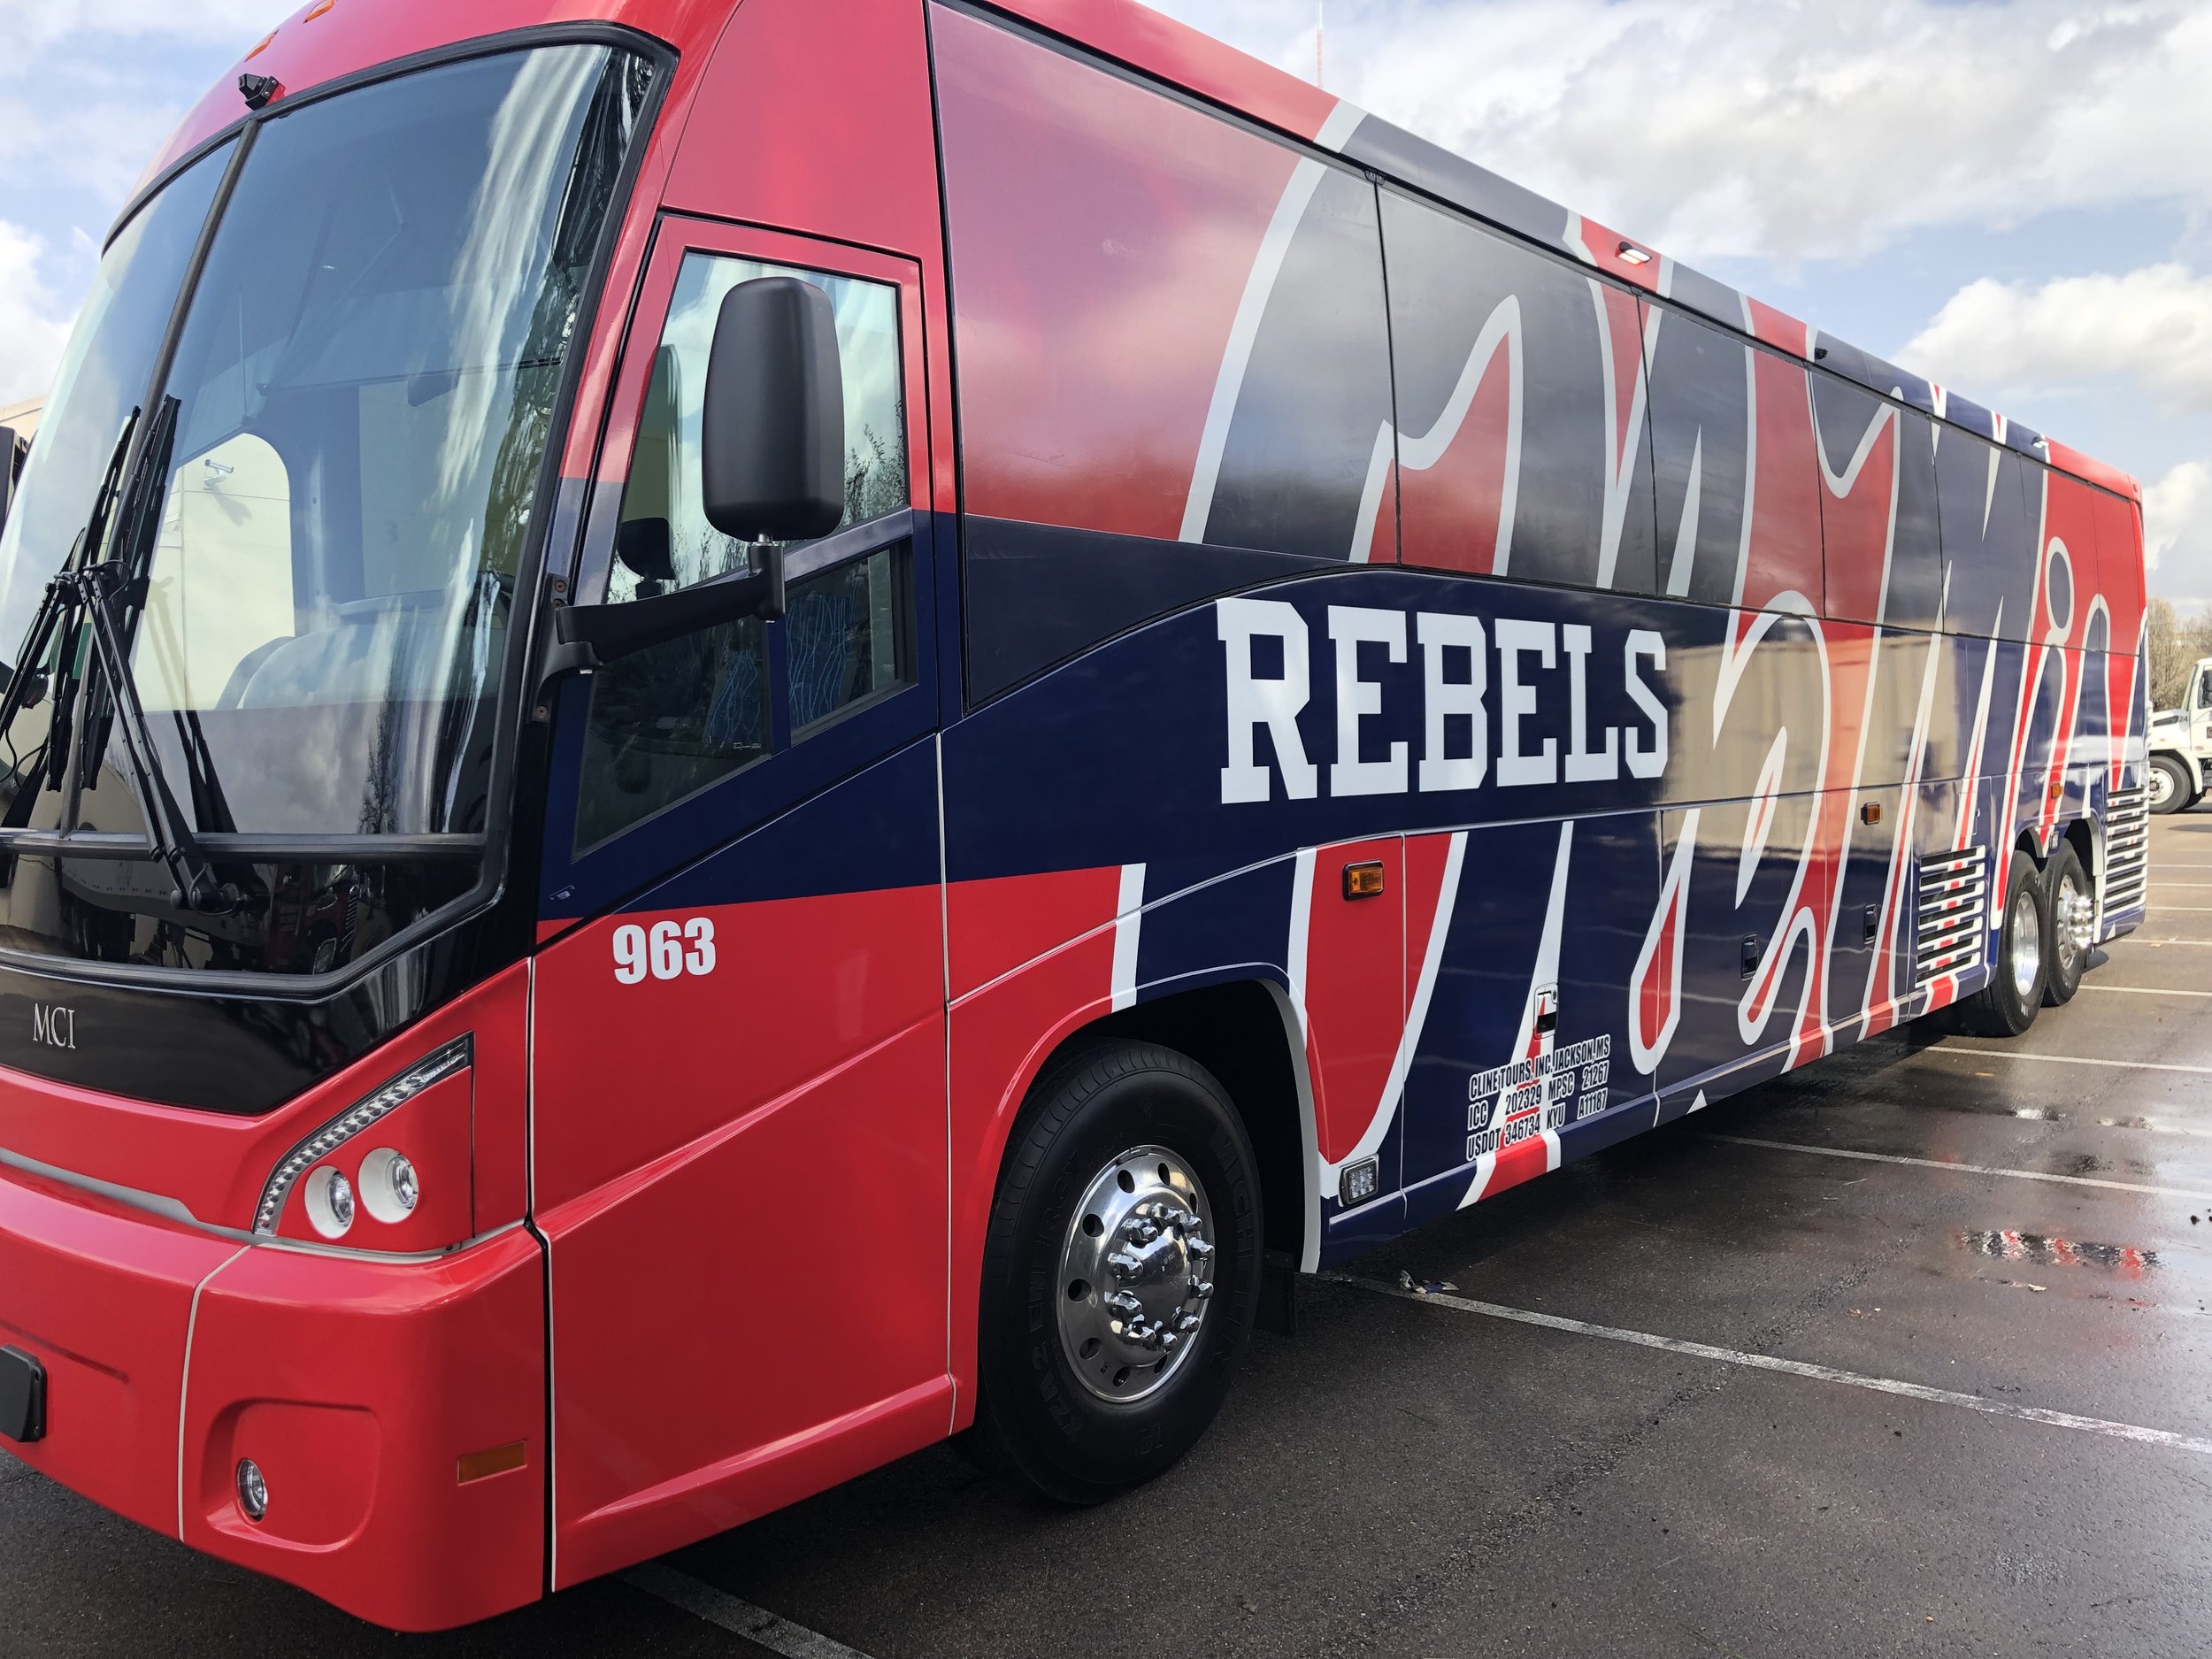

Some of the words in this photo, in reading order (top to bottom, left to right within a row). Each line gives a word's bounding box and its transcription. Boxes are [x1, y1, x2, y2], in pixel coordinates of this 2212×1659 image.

[1215, 596, 1668, 804] REBELS
[612, 917, 716, 985] 963
[32, 1002, 76, 1049] MCI
[1469, 1101, 1488, 1130] ICC
[1505, 1085, 1542, 1116] 202329
[1548, 1072, 1575, 1101] MPSC
[1582, 1061, 1609, 1090] 21267
[1470, 1072, 1499, 1100] CLINE
[1499, 1059, 1534, 1088] TOURS,
[1535, 1055, 1553, 1078] INC.
[1595, 1034, 1610, 1060] MS
[1467, 1127, 1501, 1160] USDOT
[1505, 1112, 1540, 1144] 346734
[1547, 1103, 1566, 1130] KYU
[1578, 1088, 1609, 1119] A11187
